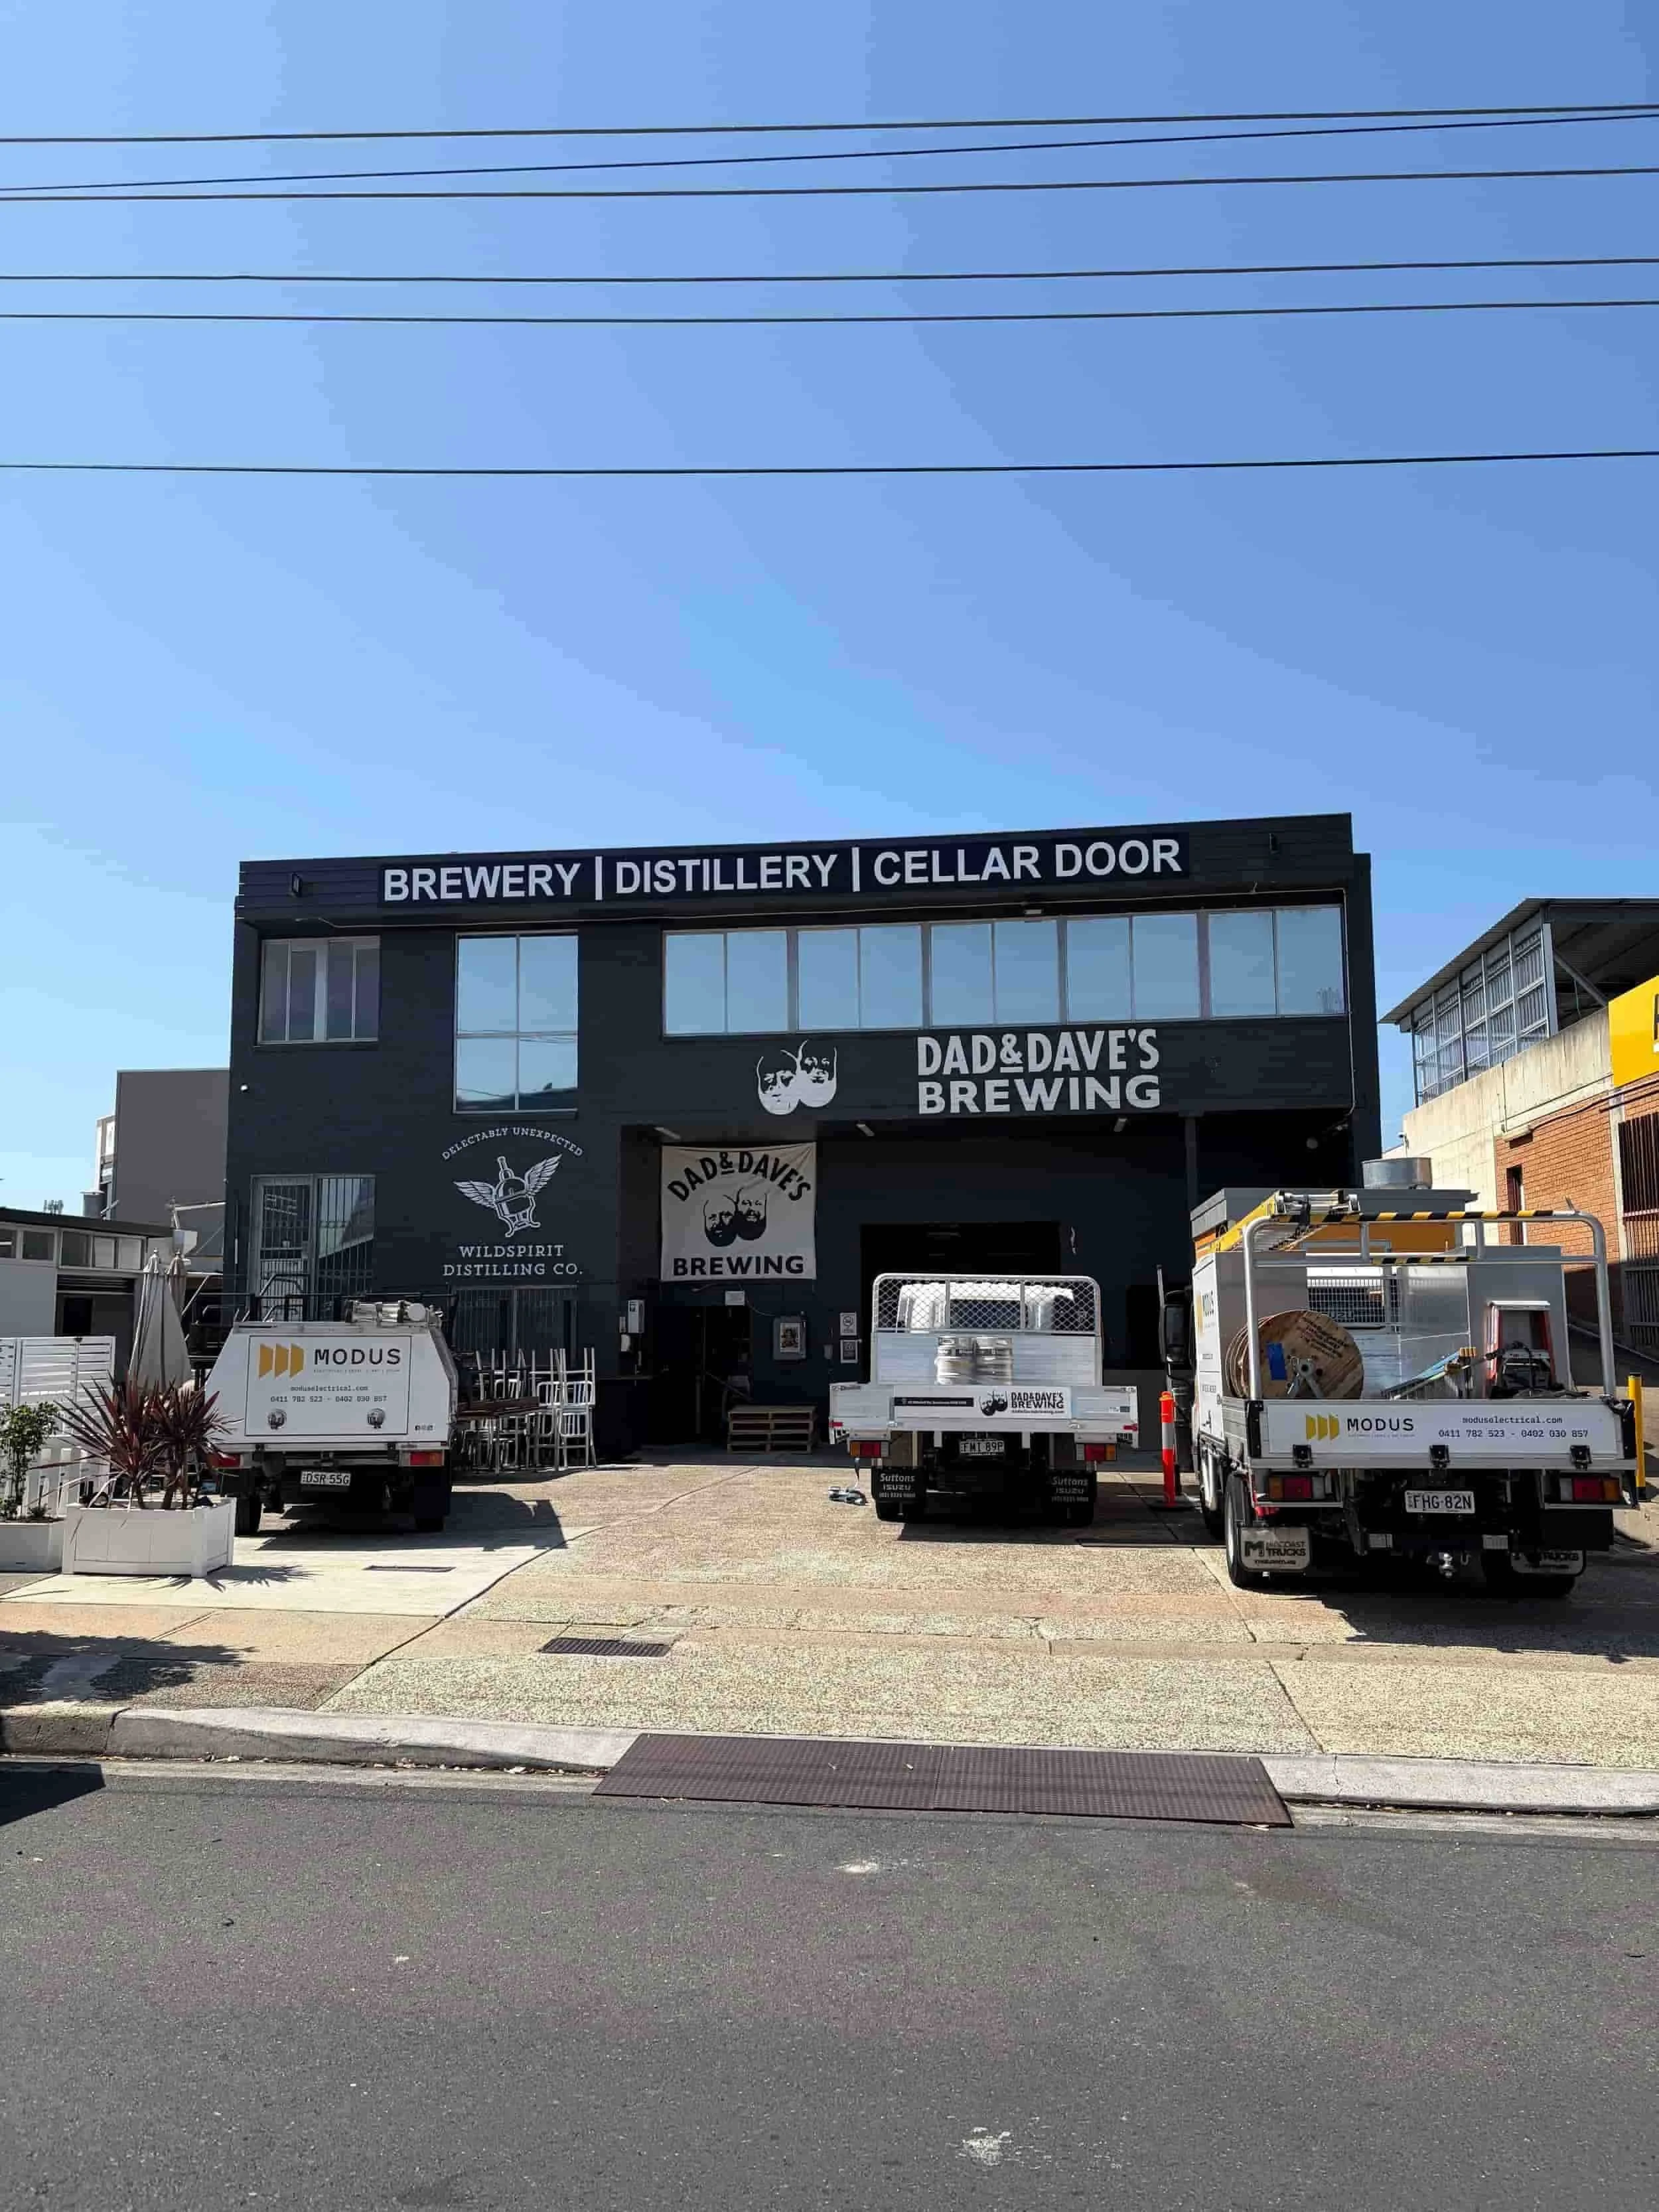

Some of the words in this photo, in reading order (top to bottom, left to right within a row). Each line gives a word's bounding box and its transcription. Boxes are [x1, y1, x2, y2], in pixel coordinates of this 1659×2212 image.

[384, 863, 581, 901] BREWERY
[615, 854, 837, 894] DISTILLERY
[873, 846, 1042, 885] CELLAR
[1055, 839, 1182, 877] DOOR
[917, 1028, 1159, 1075] DAD&DAVE'S
[918, 1074, 1161, 1115] BREWING
[441, 1128, 508, 1161] DELECTABLY
[512, 1127, 583, 1156] UNEXPECTED
[667, 1151, 811, 1202] DAD&DAVE'S
[459, 1245, 564, 1258] WILDSPIRIT
[443, 1264, 545, 1276] DISTILLING
[553, 1263, 583, 1275] CO.
[673, 1256, 804, 1276] BREWING
[314, 1348, 401, 1365] MODUS
[1346, 1418, 1415, 1432] MODUS
[1438, 1429, 1461, 1438] 0411
[1465, 1429, 1483, 1438] 782
[1488, 1429, 1505, 1438] 523
[1520, 1429, 1544, 1438] 0402
[880, 1473, 915, 1482] Suttons
[1267, 1548, 1306, 1556] TRUCKS
